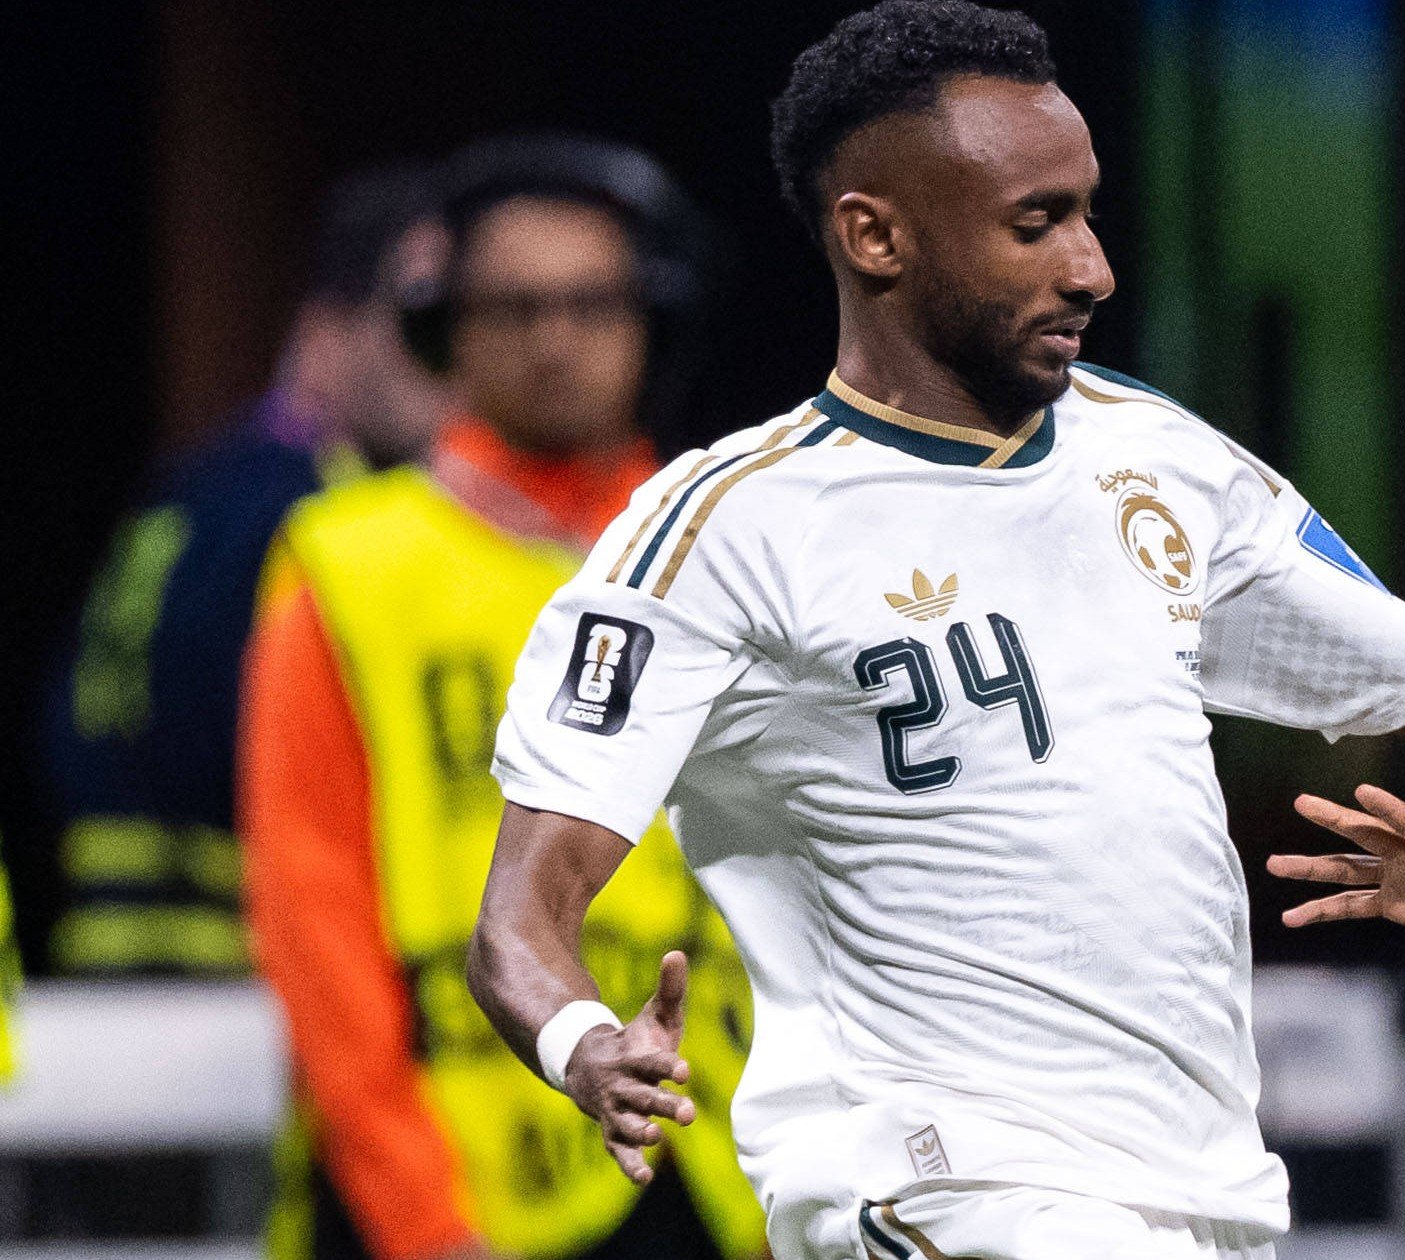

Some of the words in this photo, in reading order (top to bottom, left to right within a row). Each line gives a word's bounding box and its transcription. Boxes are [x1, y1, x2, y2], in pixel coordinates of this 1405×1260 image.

[1094, 468, 1159, 492] السعودية
[1167, 603, 1200, 622] SAUD
[852, 612, 1056, 796] 24
